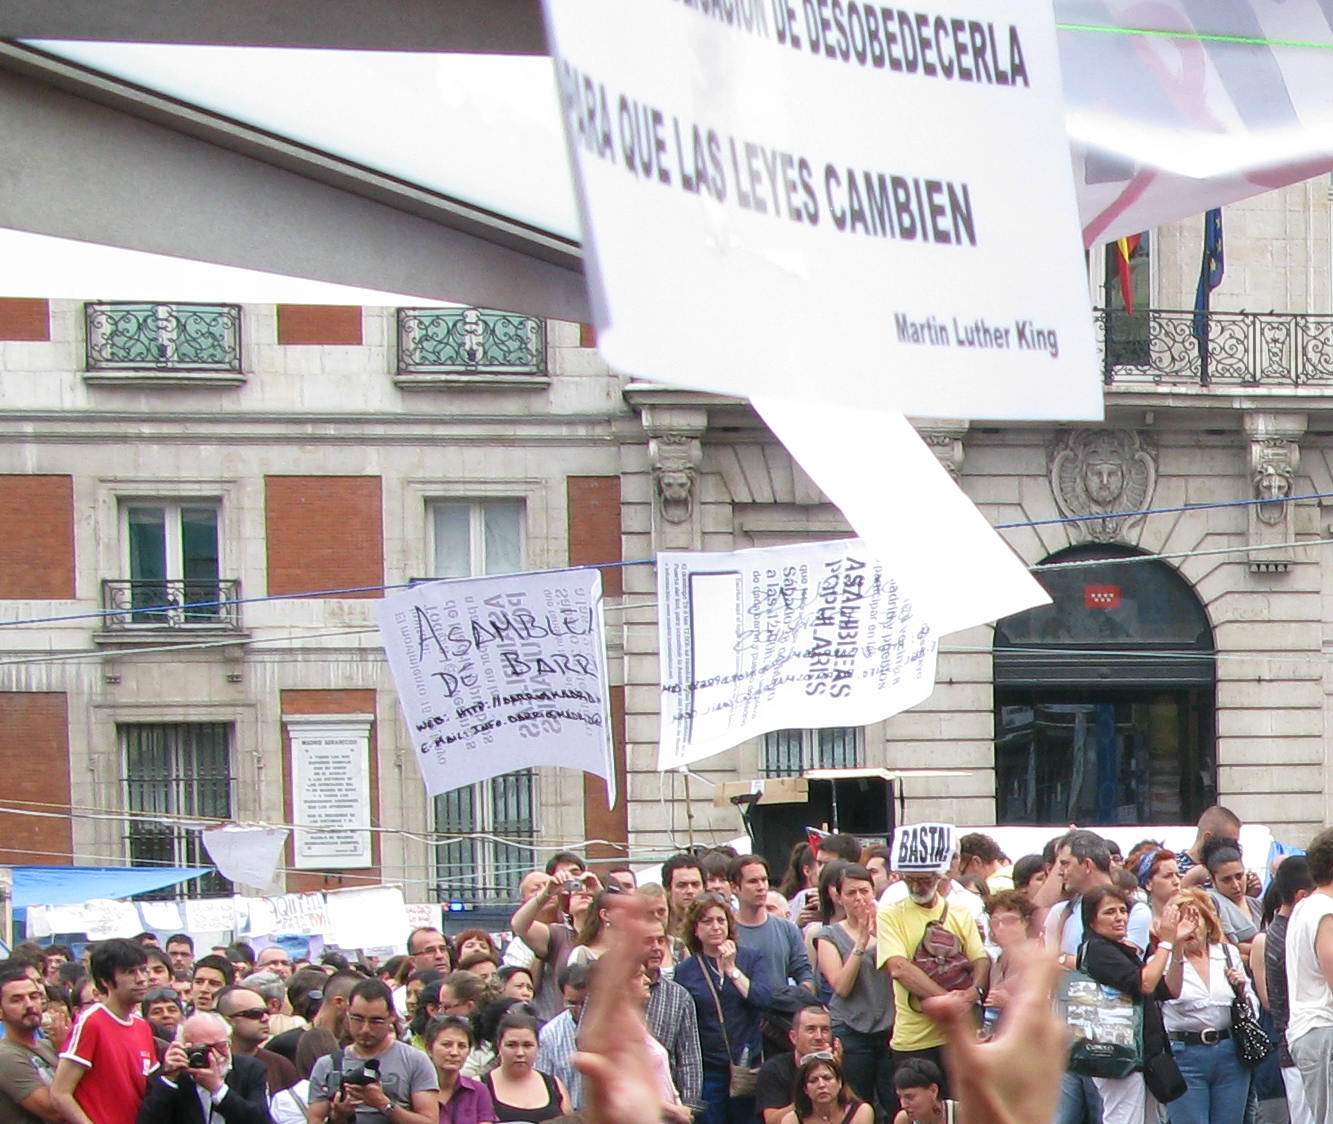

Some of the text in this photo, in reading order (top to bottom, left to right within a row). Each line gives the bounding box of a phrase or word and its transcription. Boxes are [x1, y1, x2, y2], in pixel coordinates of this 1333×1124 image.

[803, 0, 1030, 88] DESOBEDECERLA
[618, 93, 671, 187] QUE
[673, 116, 728, 203] LAS
[729, 136, 821, 226] LEYES
[824, 163, 978, 247] CAMBIEN
[894, 312, 1060, 359] Martin Luther King
[898, 826, 952, 864] BASTA!
